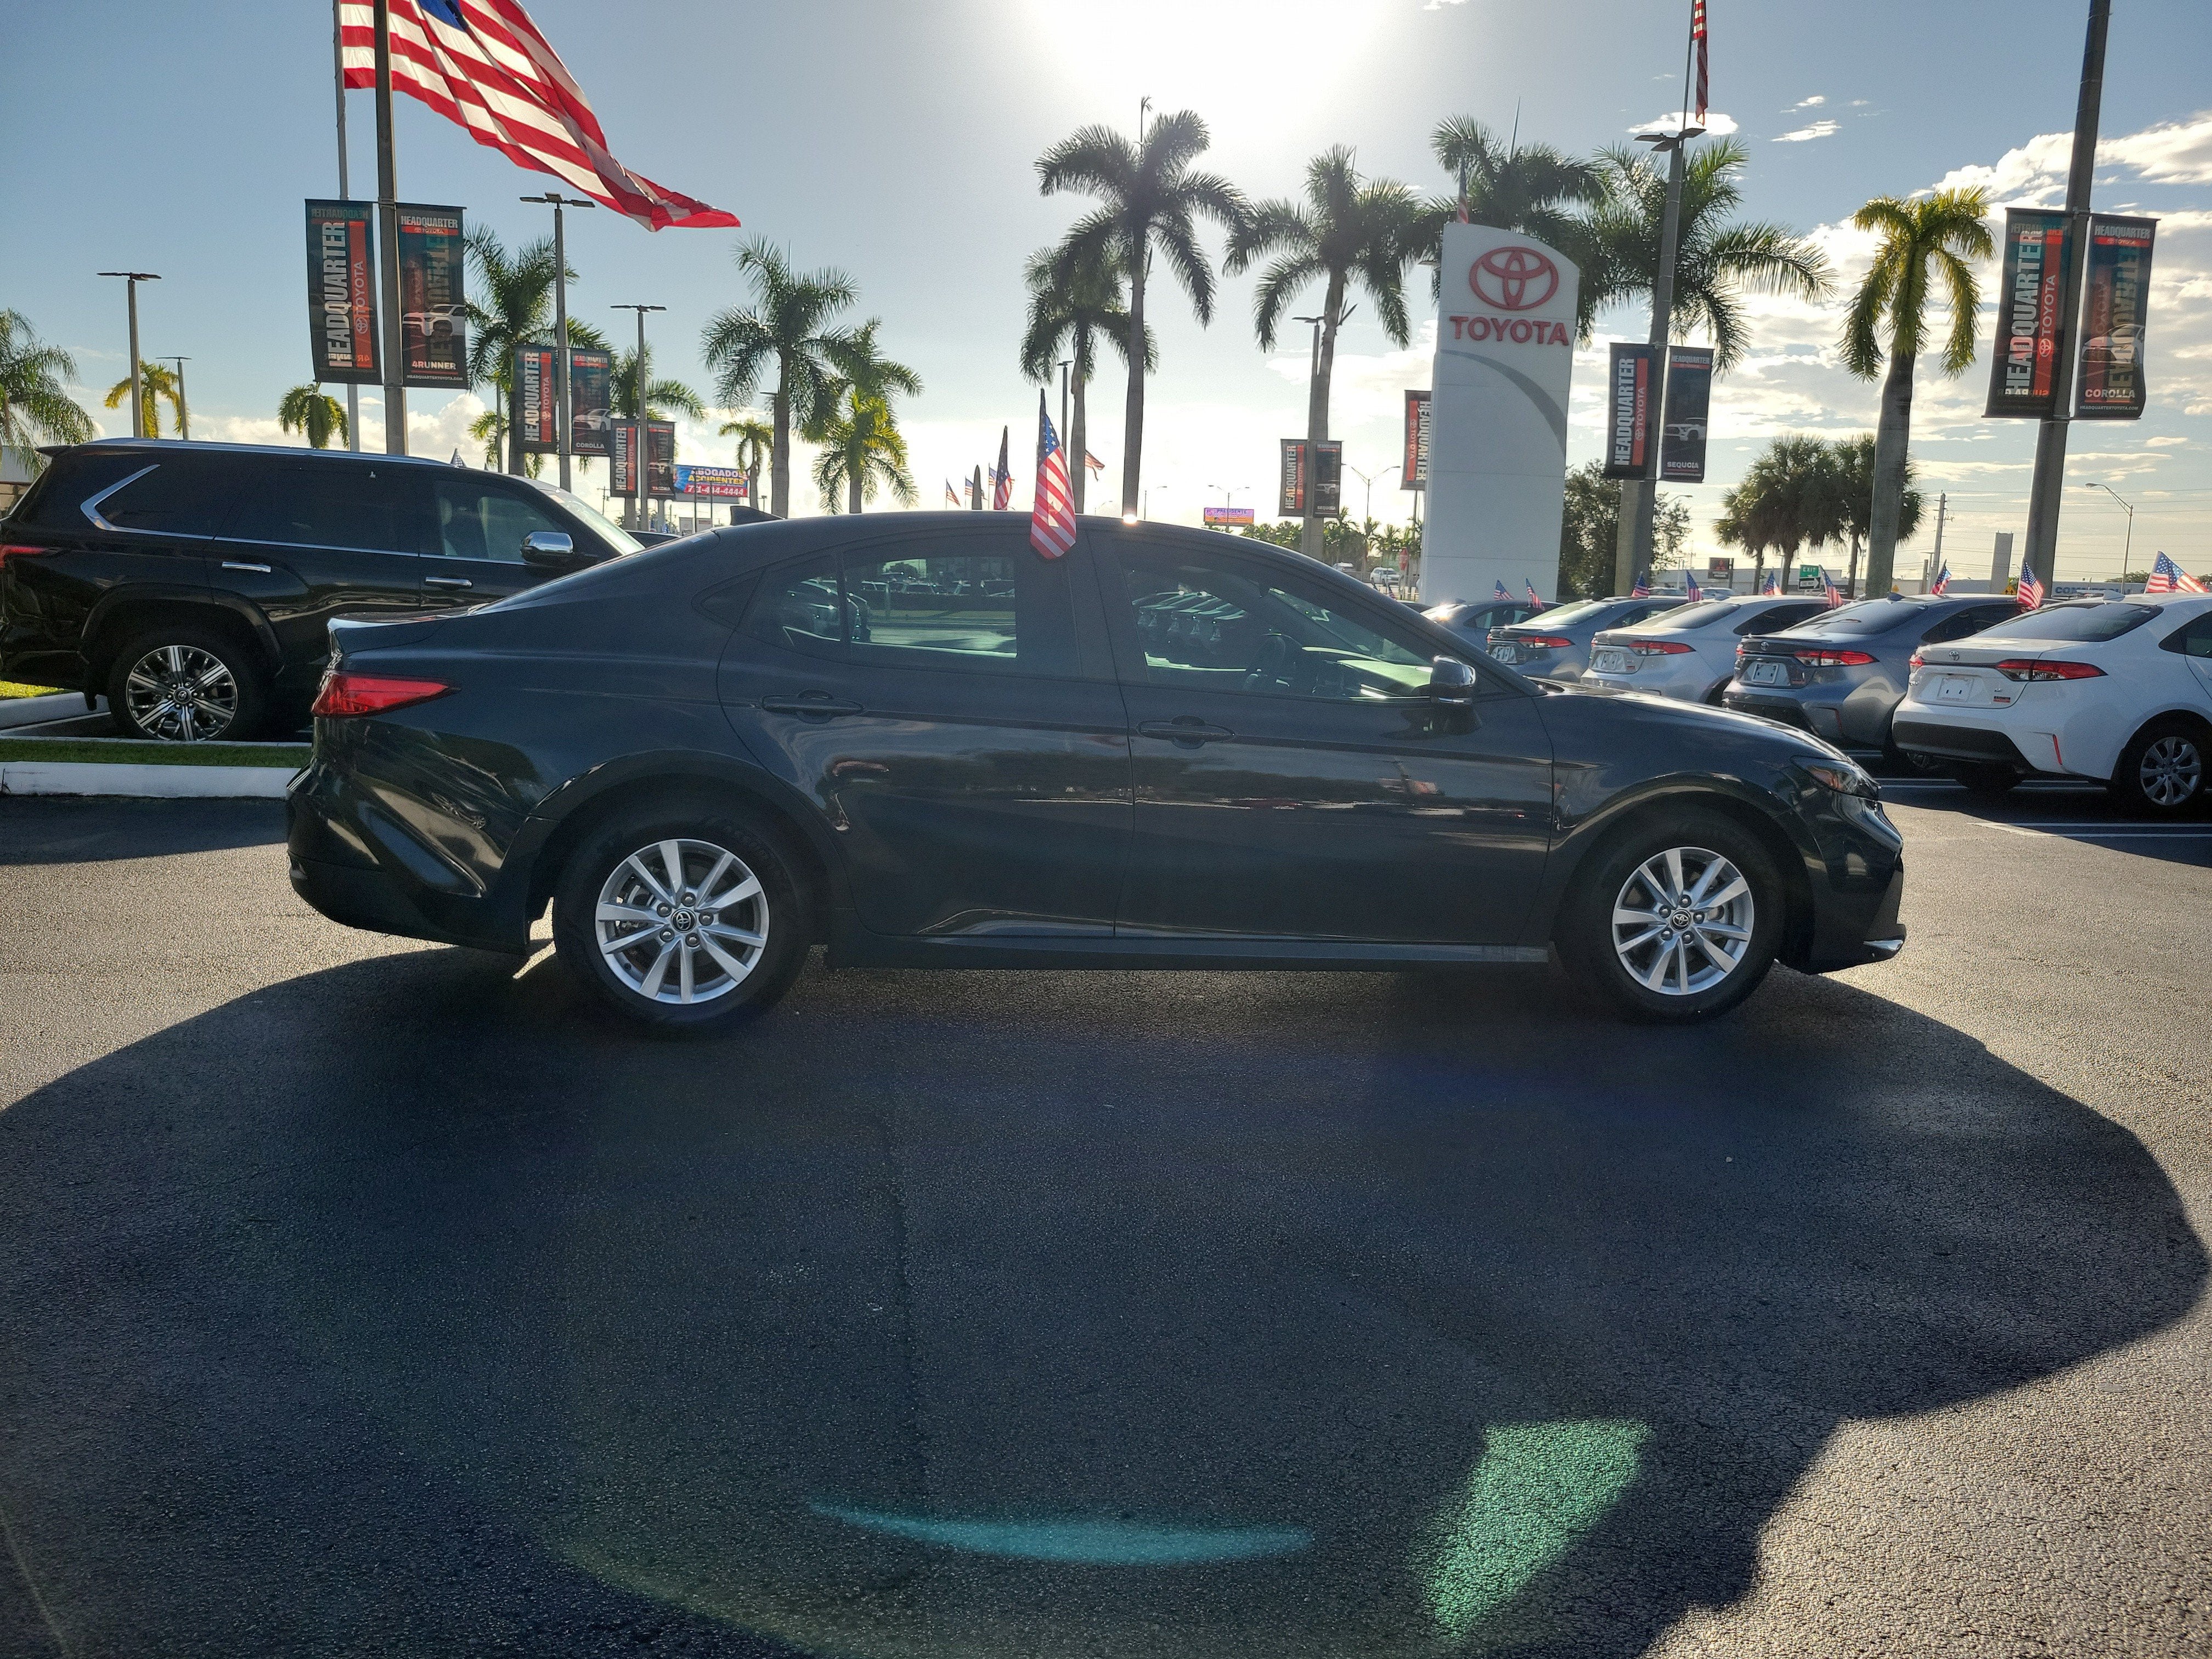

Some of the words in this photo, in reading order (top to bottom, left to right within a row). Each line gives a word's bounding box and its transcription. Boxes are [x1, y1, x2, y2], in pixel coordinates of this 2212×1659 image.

[401, 216, 458, 228] HEADQUARTER
[2095, 225, 2151, 239] HEADQUARTER
[322, 222, 353, 368] HEADQUARTER
[353, 261, 366, 314] TOYOTA
[2005, 228, 2044, 395] HEADQUARTER
[2041, 274, 2056, 337] TOYOTA
[1449, 315, 1570, 346] TOYOTA
[411, 360, 456, 370] 4RUNNER
[2085, 388, 2135, 398] COROLLA
[524, 352, 541, 442] HEADQUARTER
[1614, 358, 1635, 466] HEADQUARTER
[1636, 387, 1645, 427] TOYOTA
[615, 427, 628, 491] HEADQUARTER
[1415, 401, 1431, 481] HEADQUARTER
[1667, 461, 1699, 469] SEQUOIA
[1285, 445, 1296, 509] HEADQUARTER
